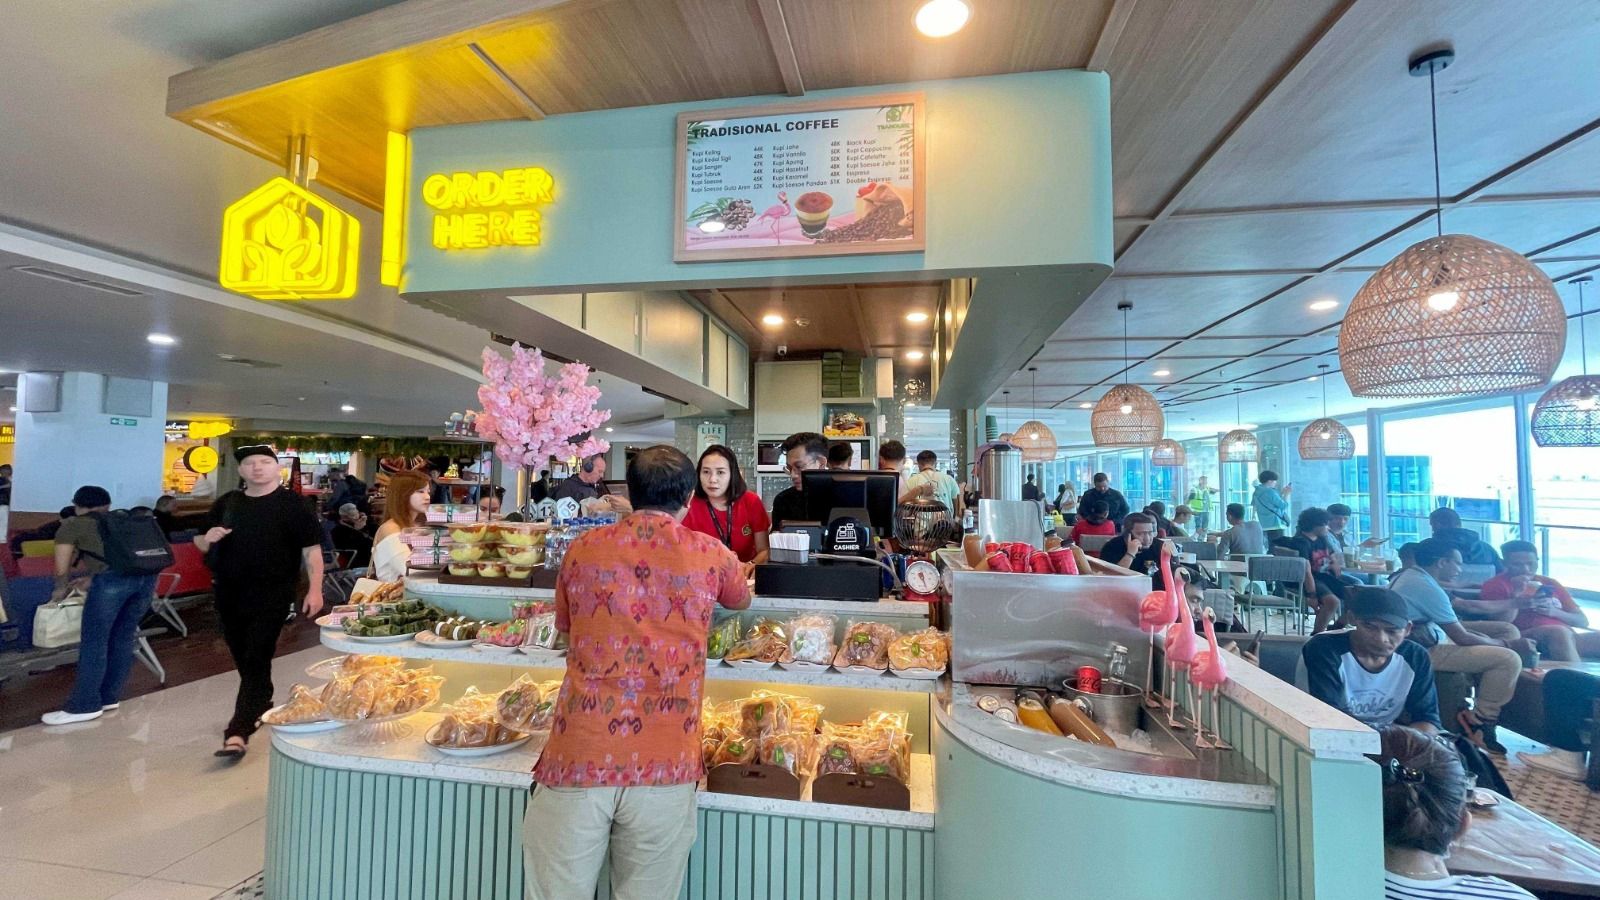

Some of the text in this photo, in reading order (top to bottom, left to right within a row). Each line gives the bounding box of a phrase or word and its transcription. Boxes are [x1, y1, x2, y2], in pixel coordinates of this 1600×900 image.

[692, 118, 838, 138] TRADISIONAL COFFEE
[423, 168, 554, 209] ORDER
[433, 210, 541, 249] HERE
[566, 501, 576, 512] 5
